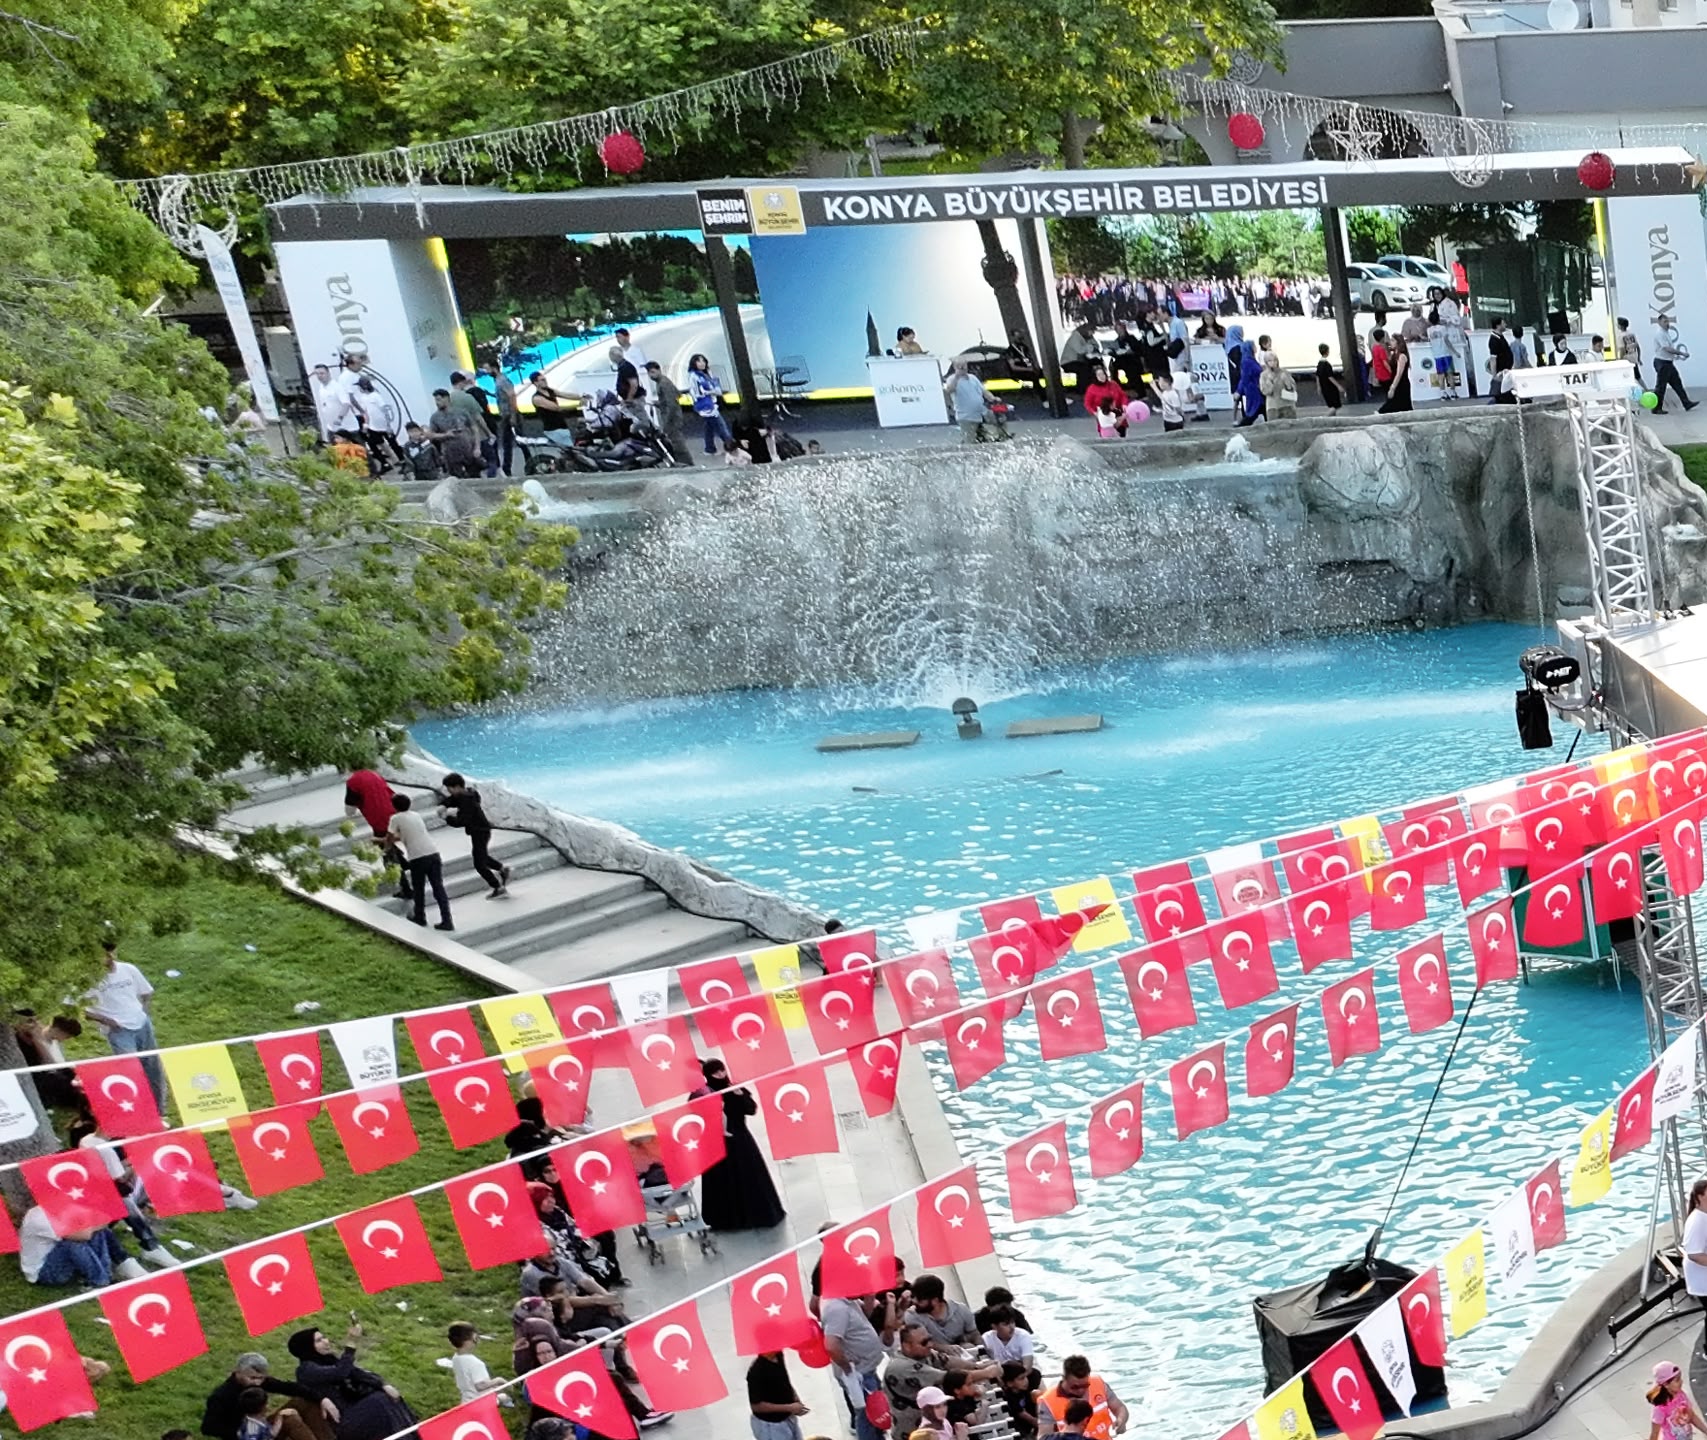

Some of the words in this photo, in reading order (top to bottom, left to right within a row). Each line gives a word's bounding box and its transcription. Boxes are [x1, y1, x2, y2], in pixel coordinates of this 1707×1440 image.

[823, 192, 938, 221] KONYA
[945, 182, 1145, 217] BÜYÜKŞEHİR
[1154, 176, 1328, 209] BELEDİYESİ
[1563, 373, 1588, 385] TAF
